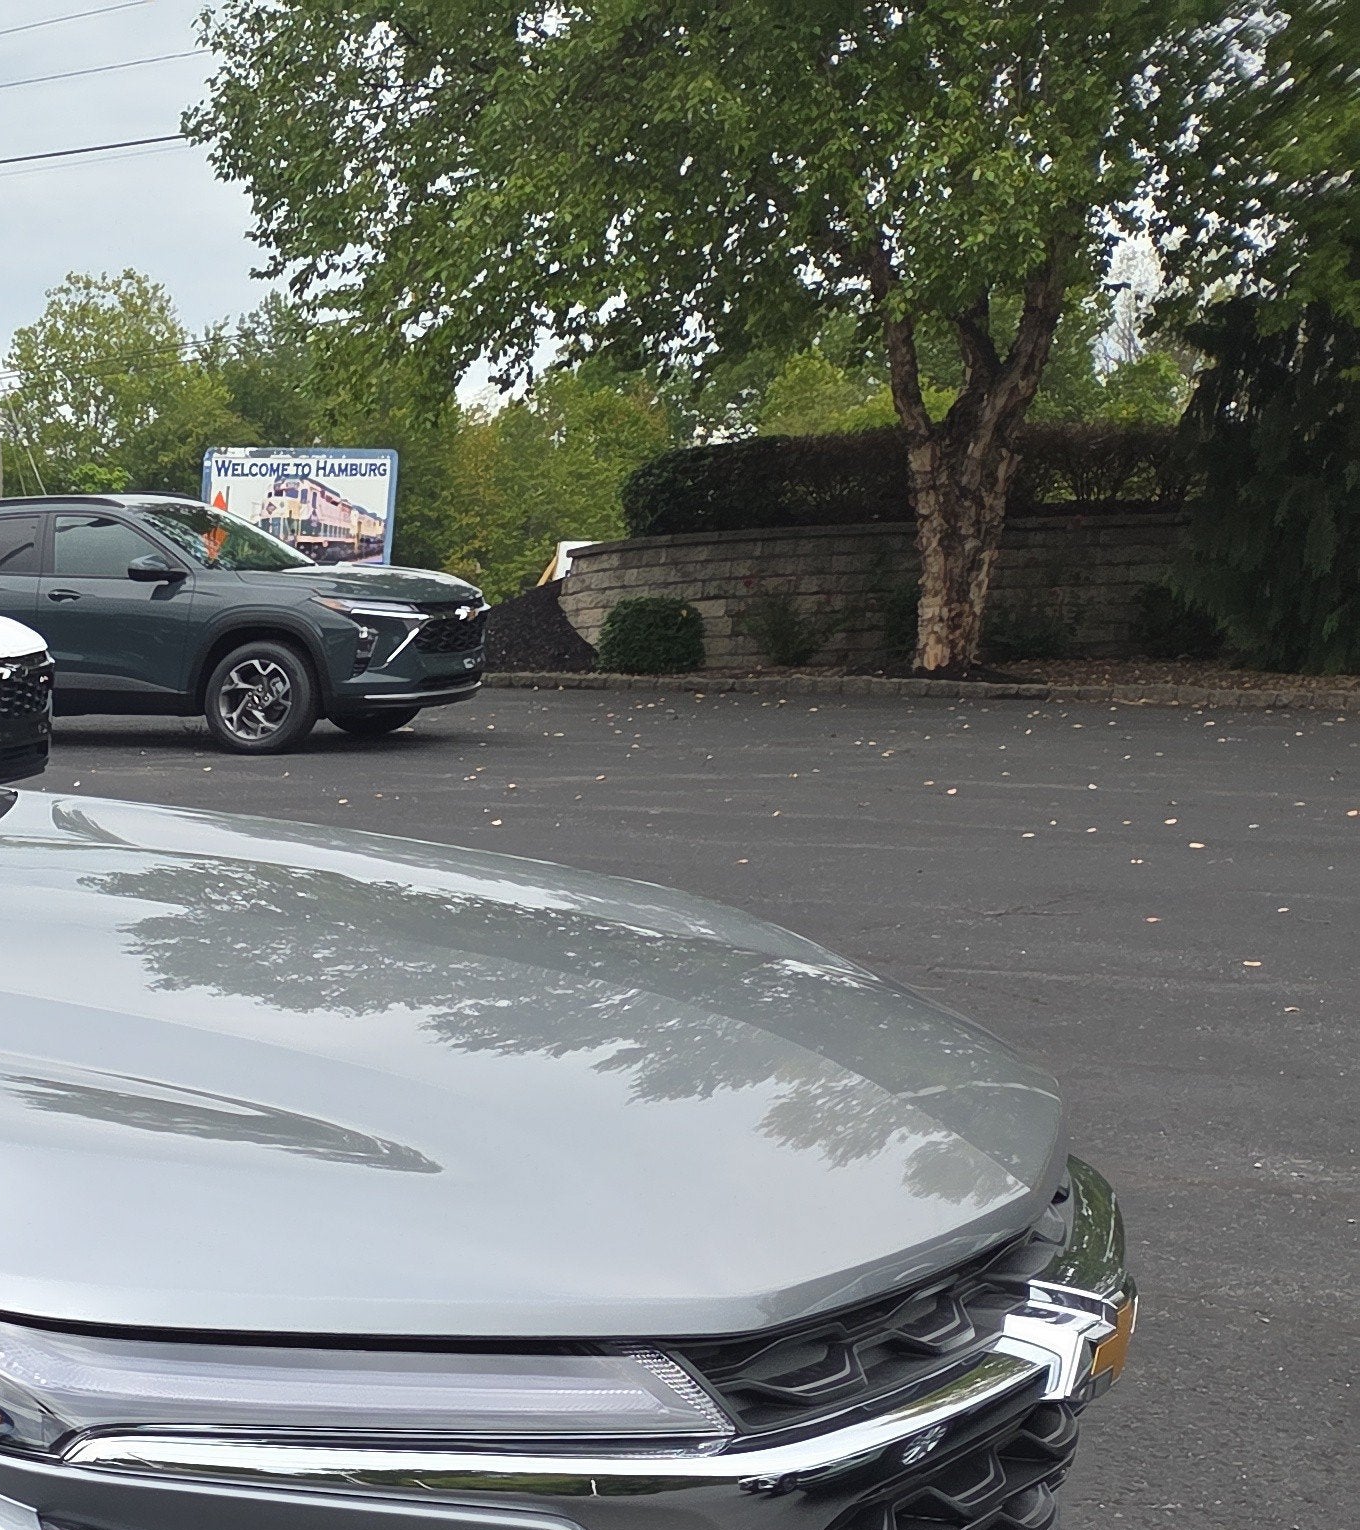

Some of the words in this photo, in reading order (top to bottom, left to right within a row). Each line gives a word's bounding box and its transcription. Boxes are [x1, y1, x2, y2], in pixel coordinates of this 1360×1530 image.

[215, 460, 292, 478] WELCOME
[293, 462, 312, 478] TO
[315, 460, 387, 478] HAMBURG
